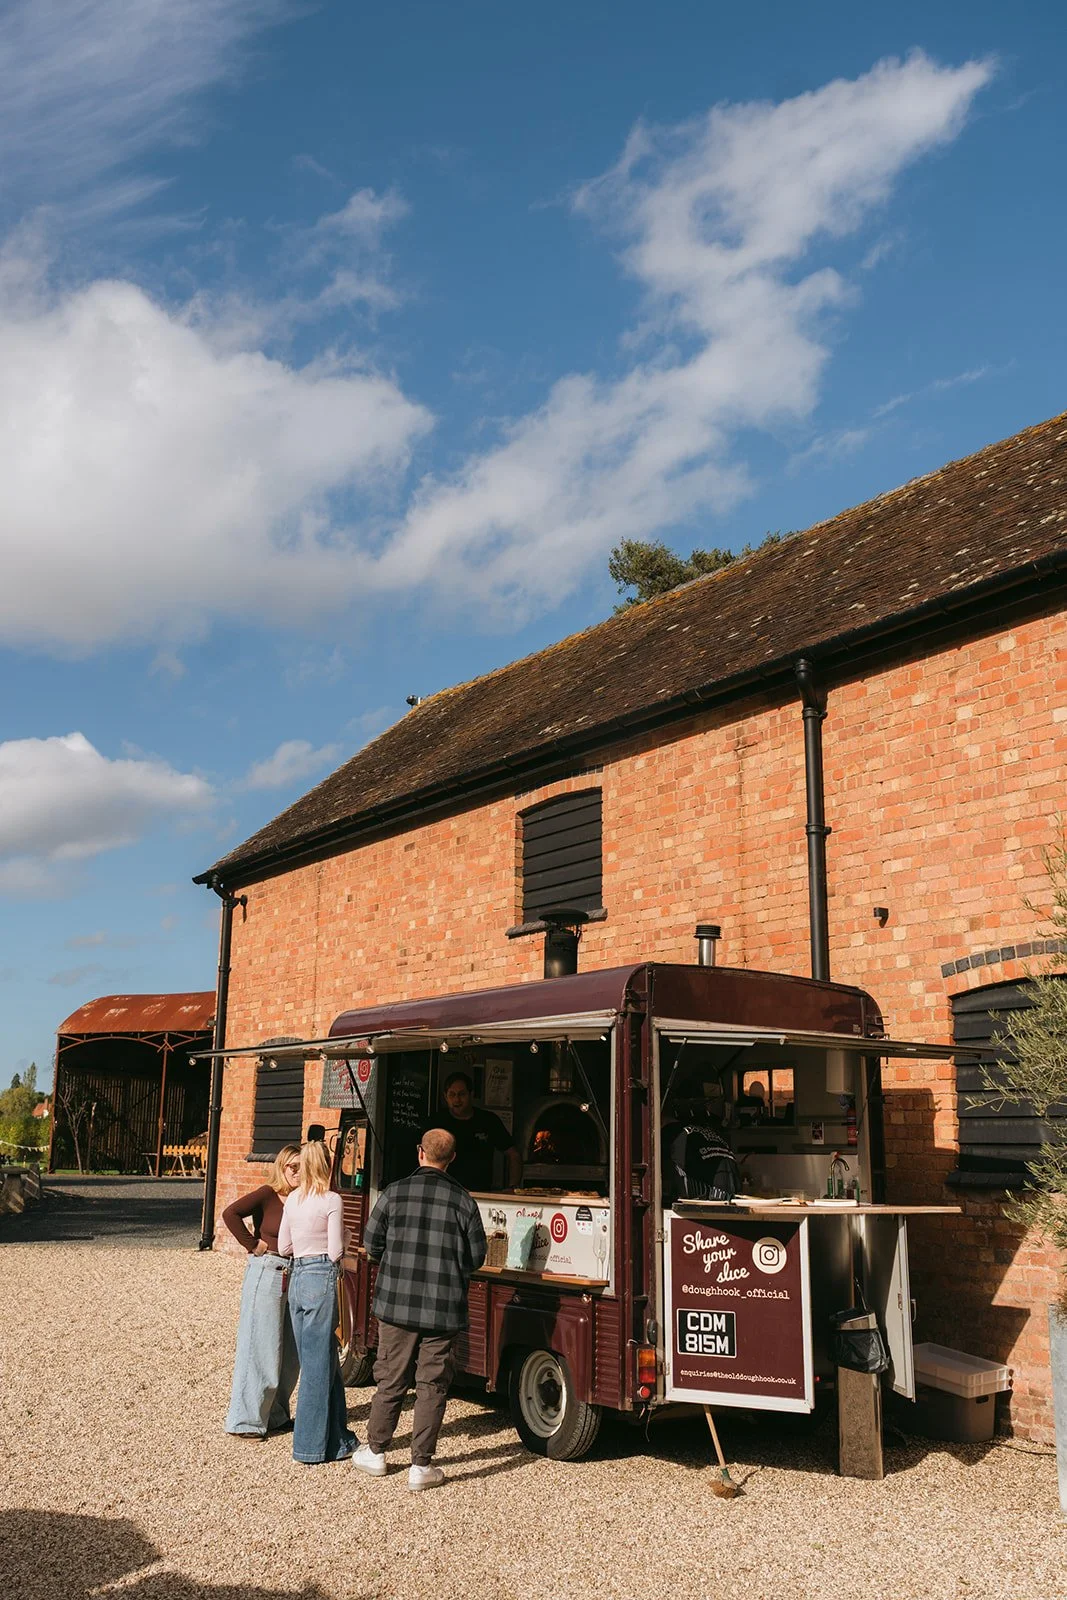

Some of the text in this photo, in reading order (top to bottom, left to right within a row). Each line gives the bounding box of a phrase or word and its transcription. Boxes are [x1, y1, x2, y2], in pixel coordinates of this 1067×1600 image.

[683, 1230, 730, 1254] Share
[703, 1247, 737, 1273] your
[716, 1261, 750, 1283] slice
[681, 1284, 790, 1300] @doughhook_official
[686, 1312, 726, 1333] CDM
[685, 1333, 729, 1355] 815M
